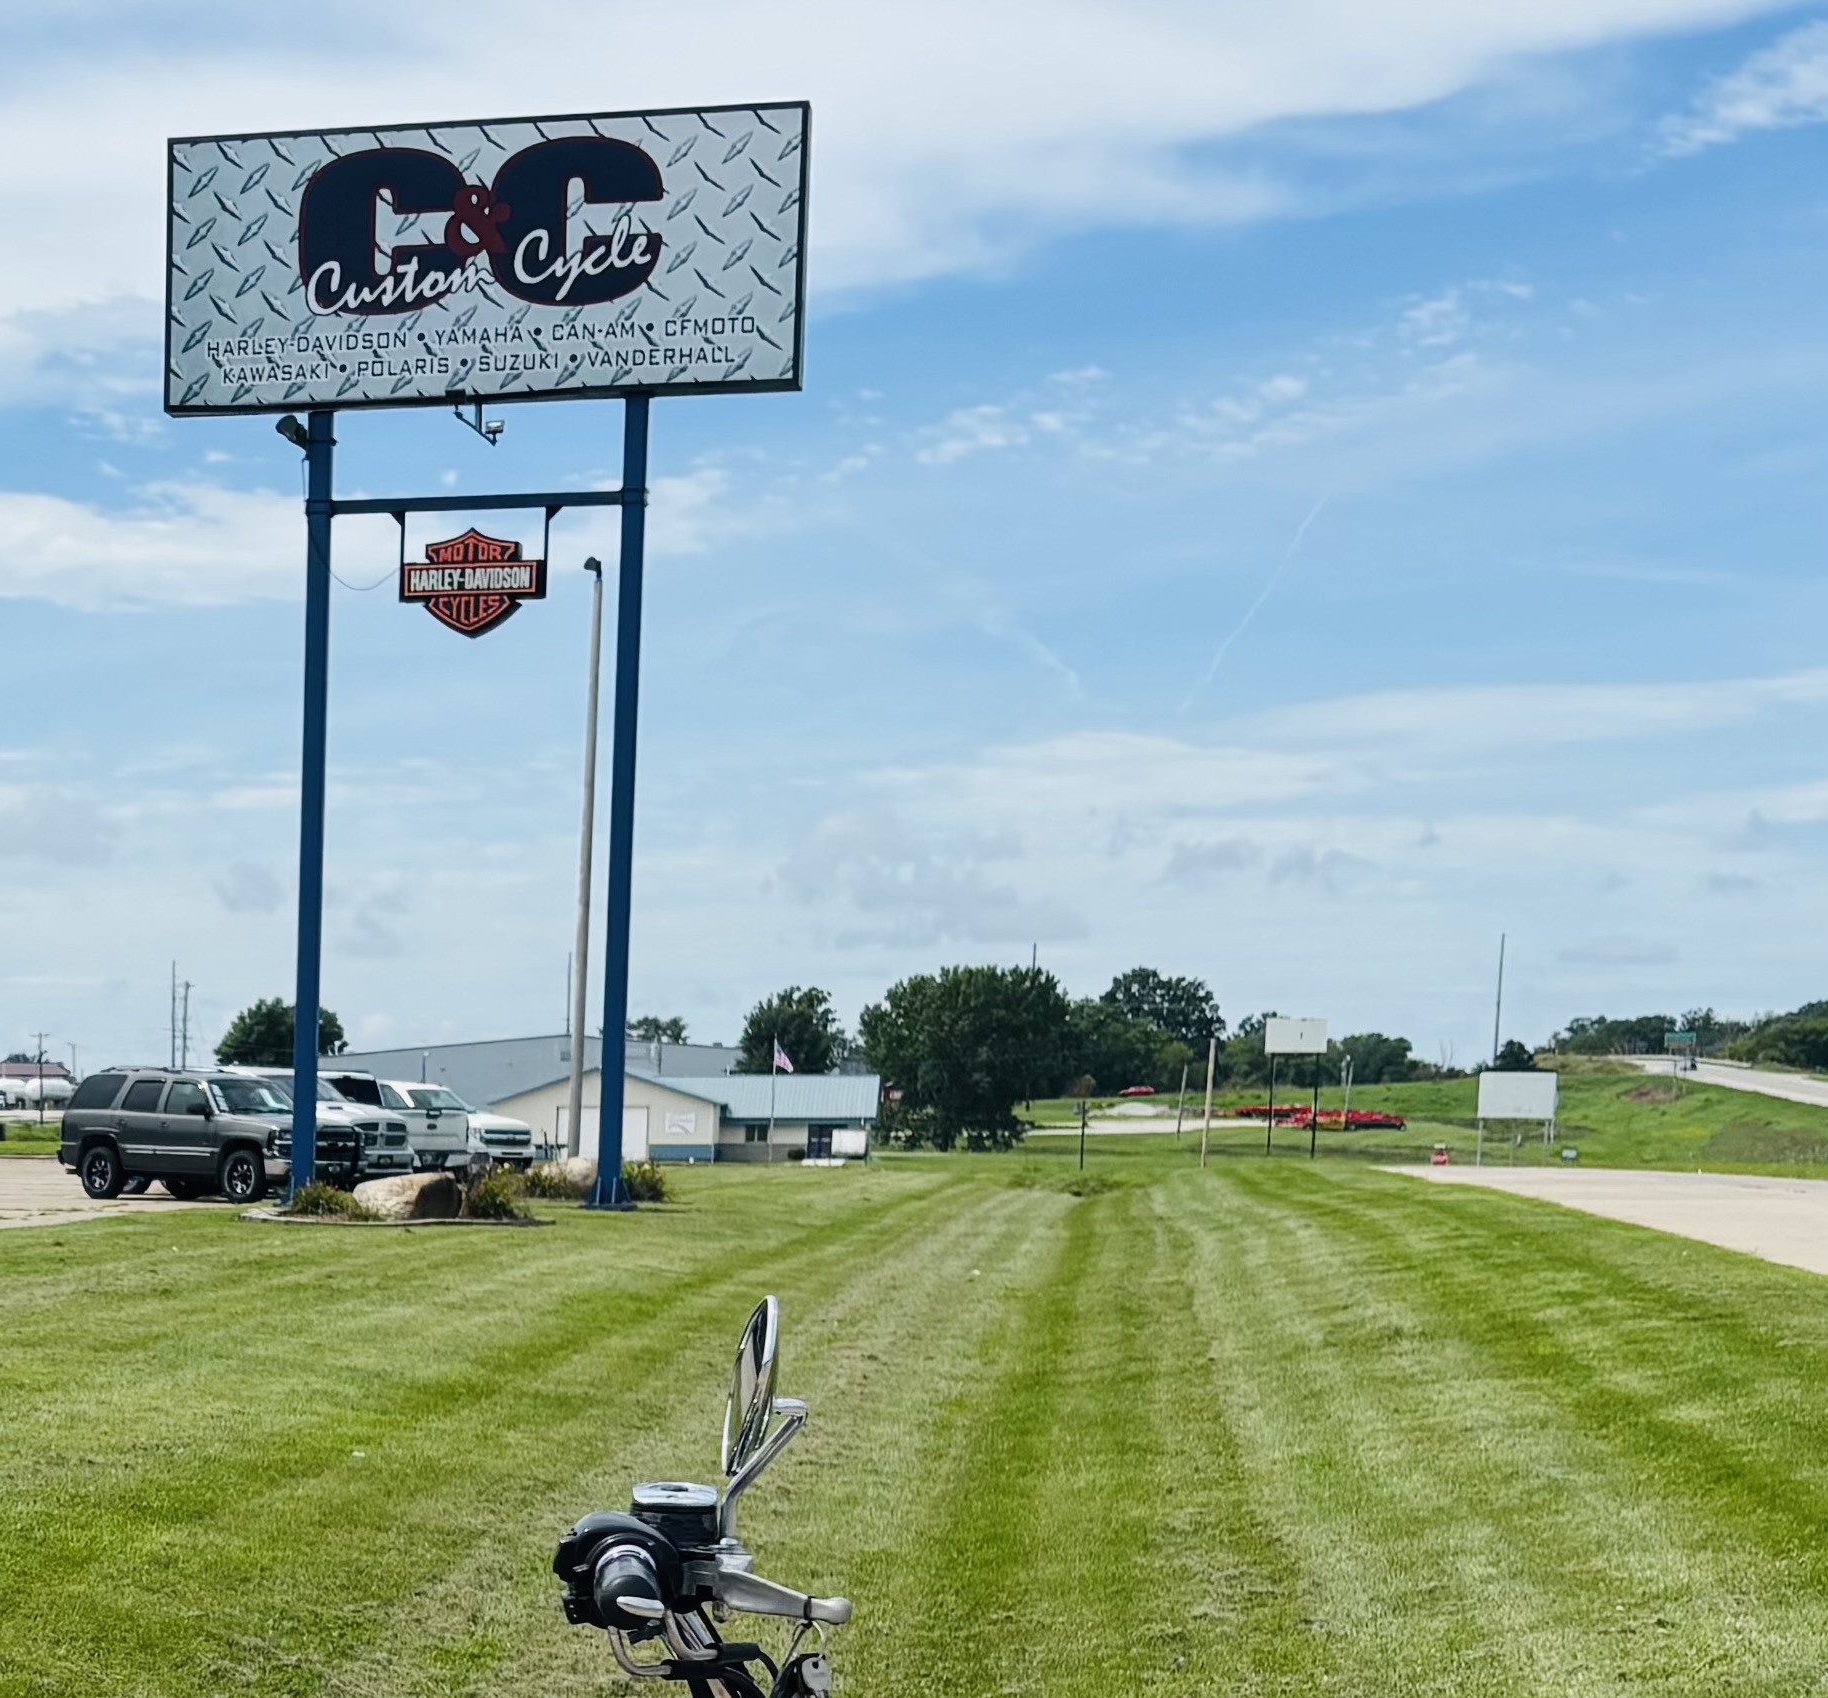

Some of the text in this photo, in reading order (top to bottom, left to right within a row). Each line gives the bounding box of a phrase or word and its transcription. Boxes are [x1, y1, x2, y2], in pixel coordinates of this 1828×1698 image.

[299, 136, 664, 315] C&C
[307, 214, 652, 316] Custom Cycle
[206, 316, 756, 358] HARLEY-DAVIDSON YAMAHA CAN-AM CFMOTO
[223, 346, 736, 385] KAWASAKI POLARIS SUZUKI VANDERHALL
[438, 538, 502, 562] MOTOR
[410, 566, 531, 592] HARLEY-DAVIDSON
[438, 595, 501, 624] CYCLES
